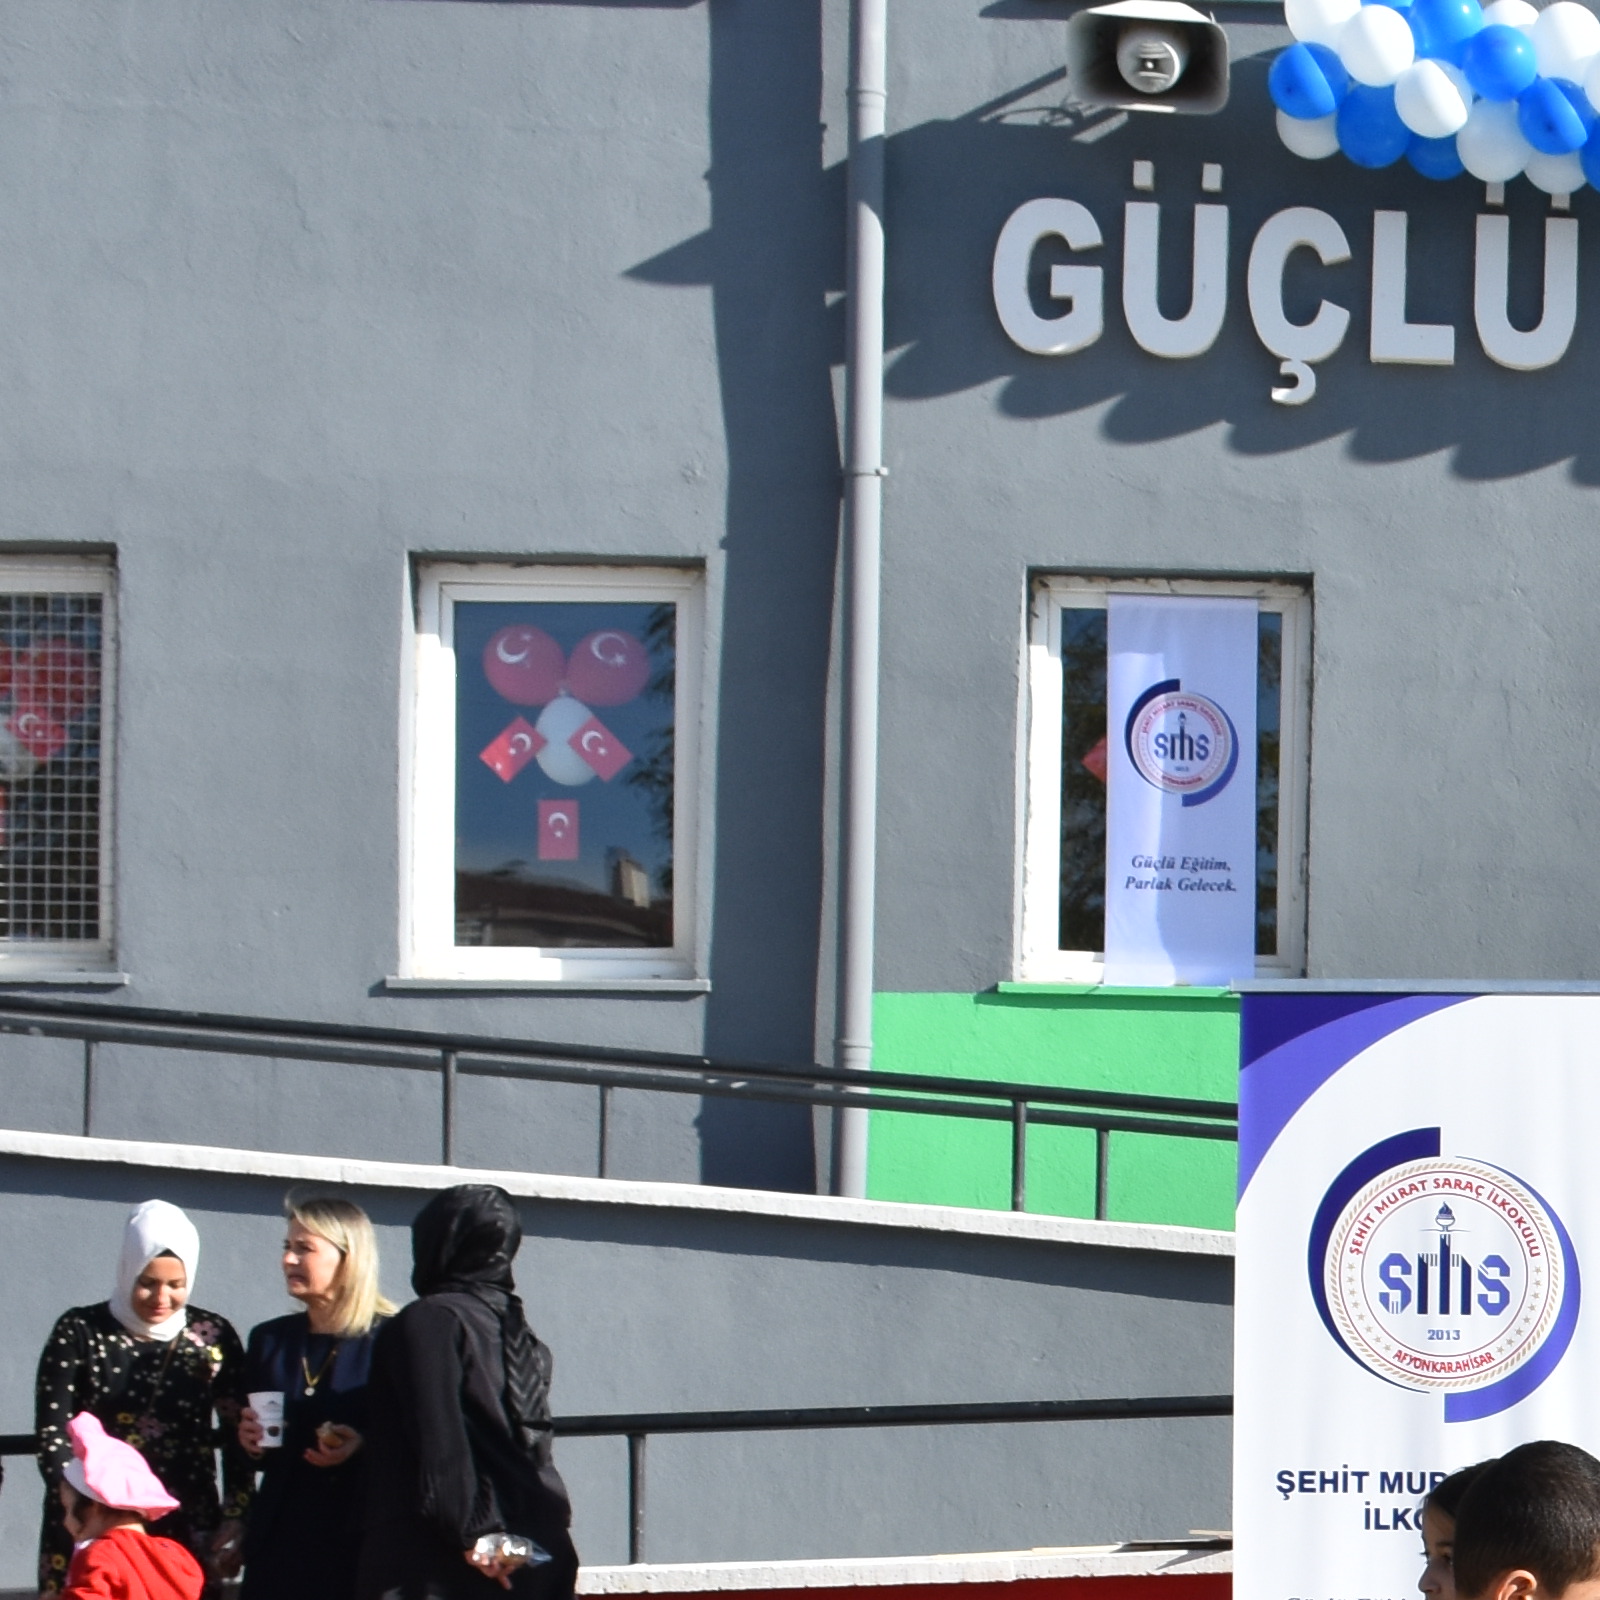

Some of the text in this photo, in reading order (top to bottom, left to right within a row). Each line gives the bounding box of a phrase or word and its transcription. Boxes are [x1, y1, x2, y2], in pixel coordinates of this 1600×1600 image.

[993, 160, 1579, 405] GÜÇLÜ
[1125, 876, 1173, 890] Parlak
[1349, 1177, 1541, 1258] ŞEHİT MURAT SARAÇ İLKOKULU
[1427, 1329, 1461, 1341] 2013
[1393, 1348, 1496, 1374] AFYONKARAHİSAR
[1276, 1464, 1370, 1500] ŞEHİT
